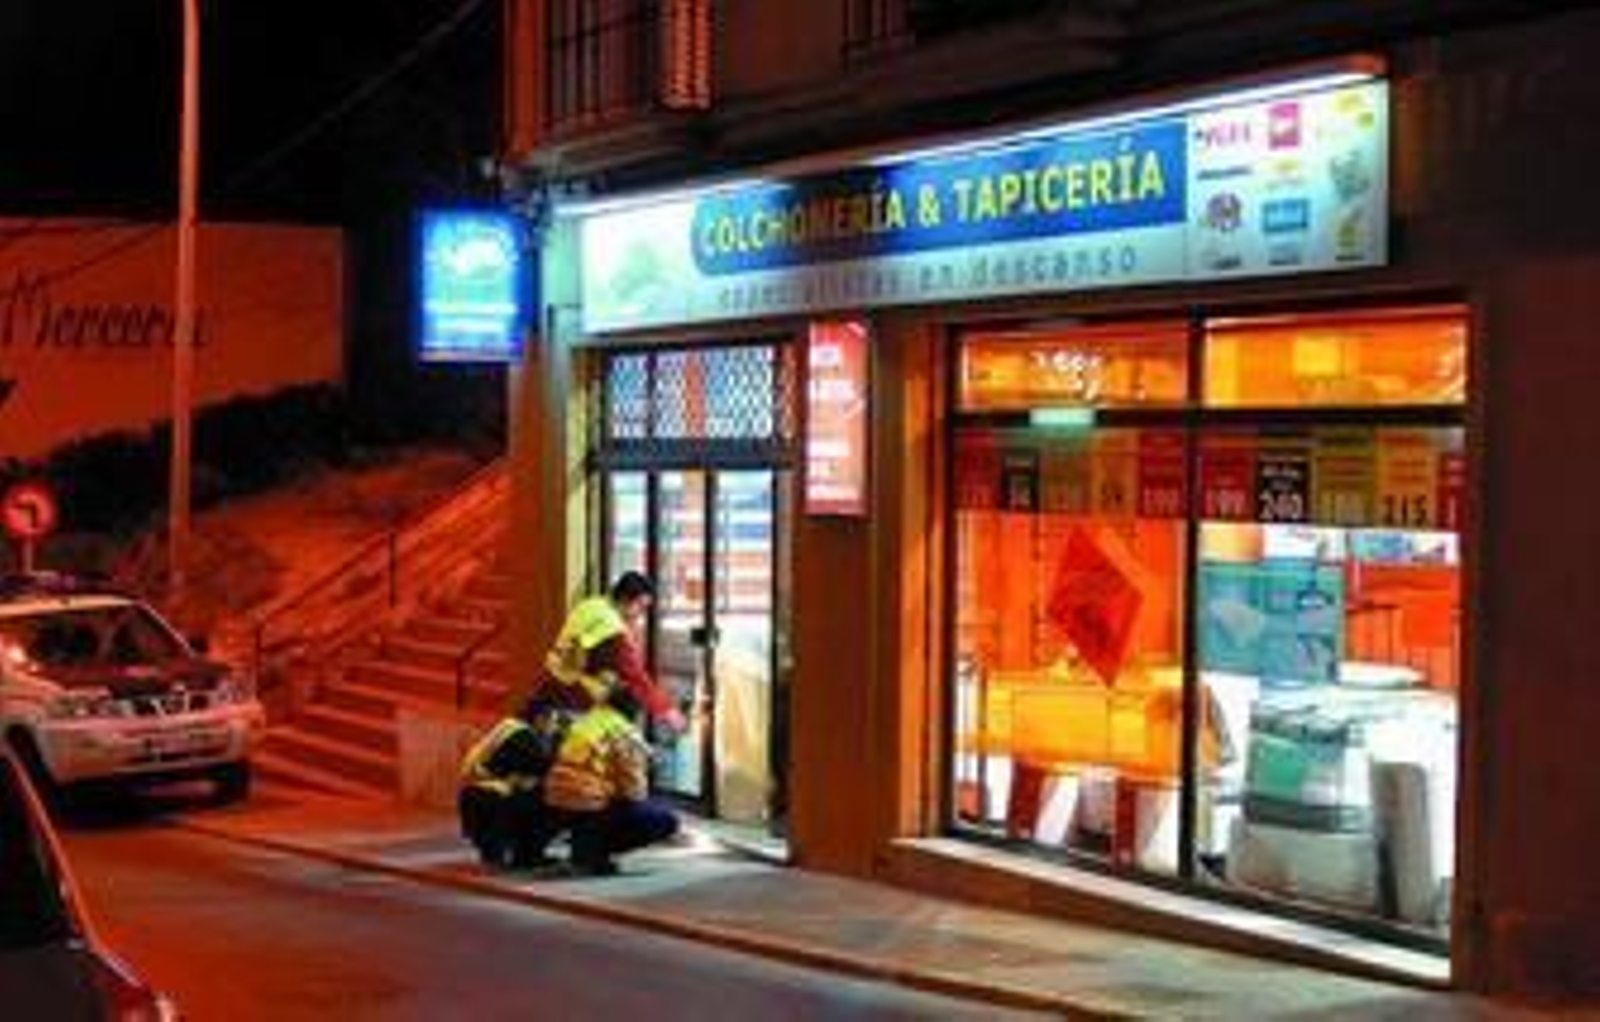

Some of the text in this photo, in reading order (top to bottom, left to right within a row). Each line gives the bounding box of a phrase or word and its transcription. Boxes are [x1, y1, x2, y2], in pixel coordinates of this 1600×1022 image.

[702, 177, 906, 257] COLCHONERÍA
[918, 184, 941, 229] &
[953, 137, 1166, 223] TAPICERÍA
[972, 245, 1137, 286] descanso
